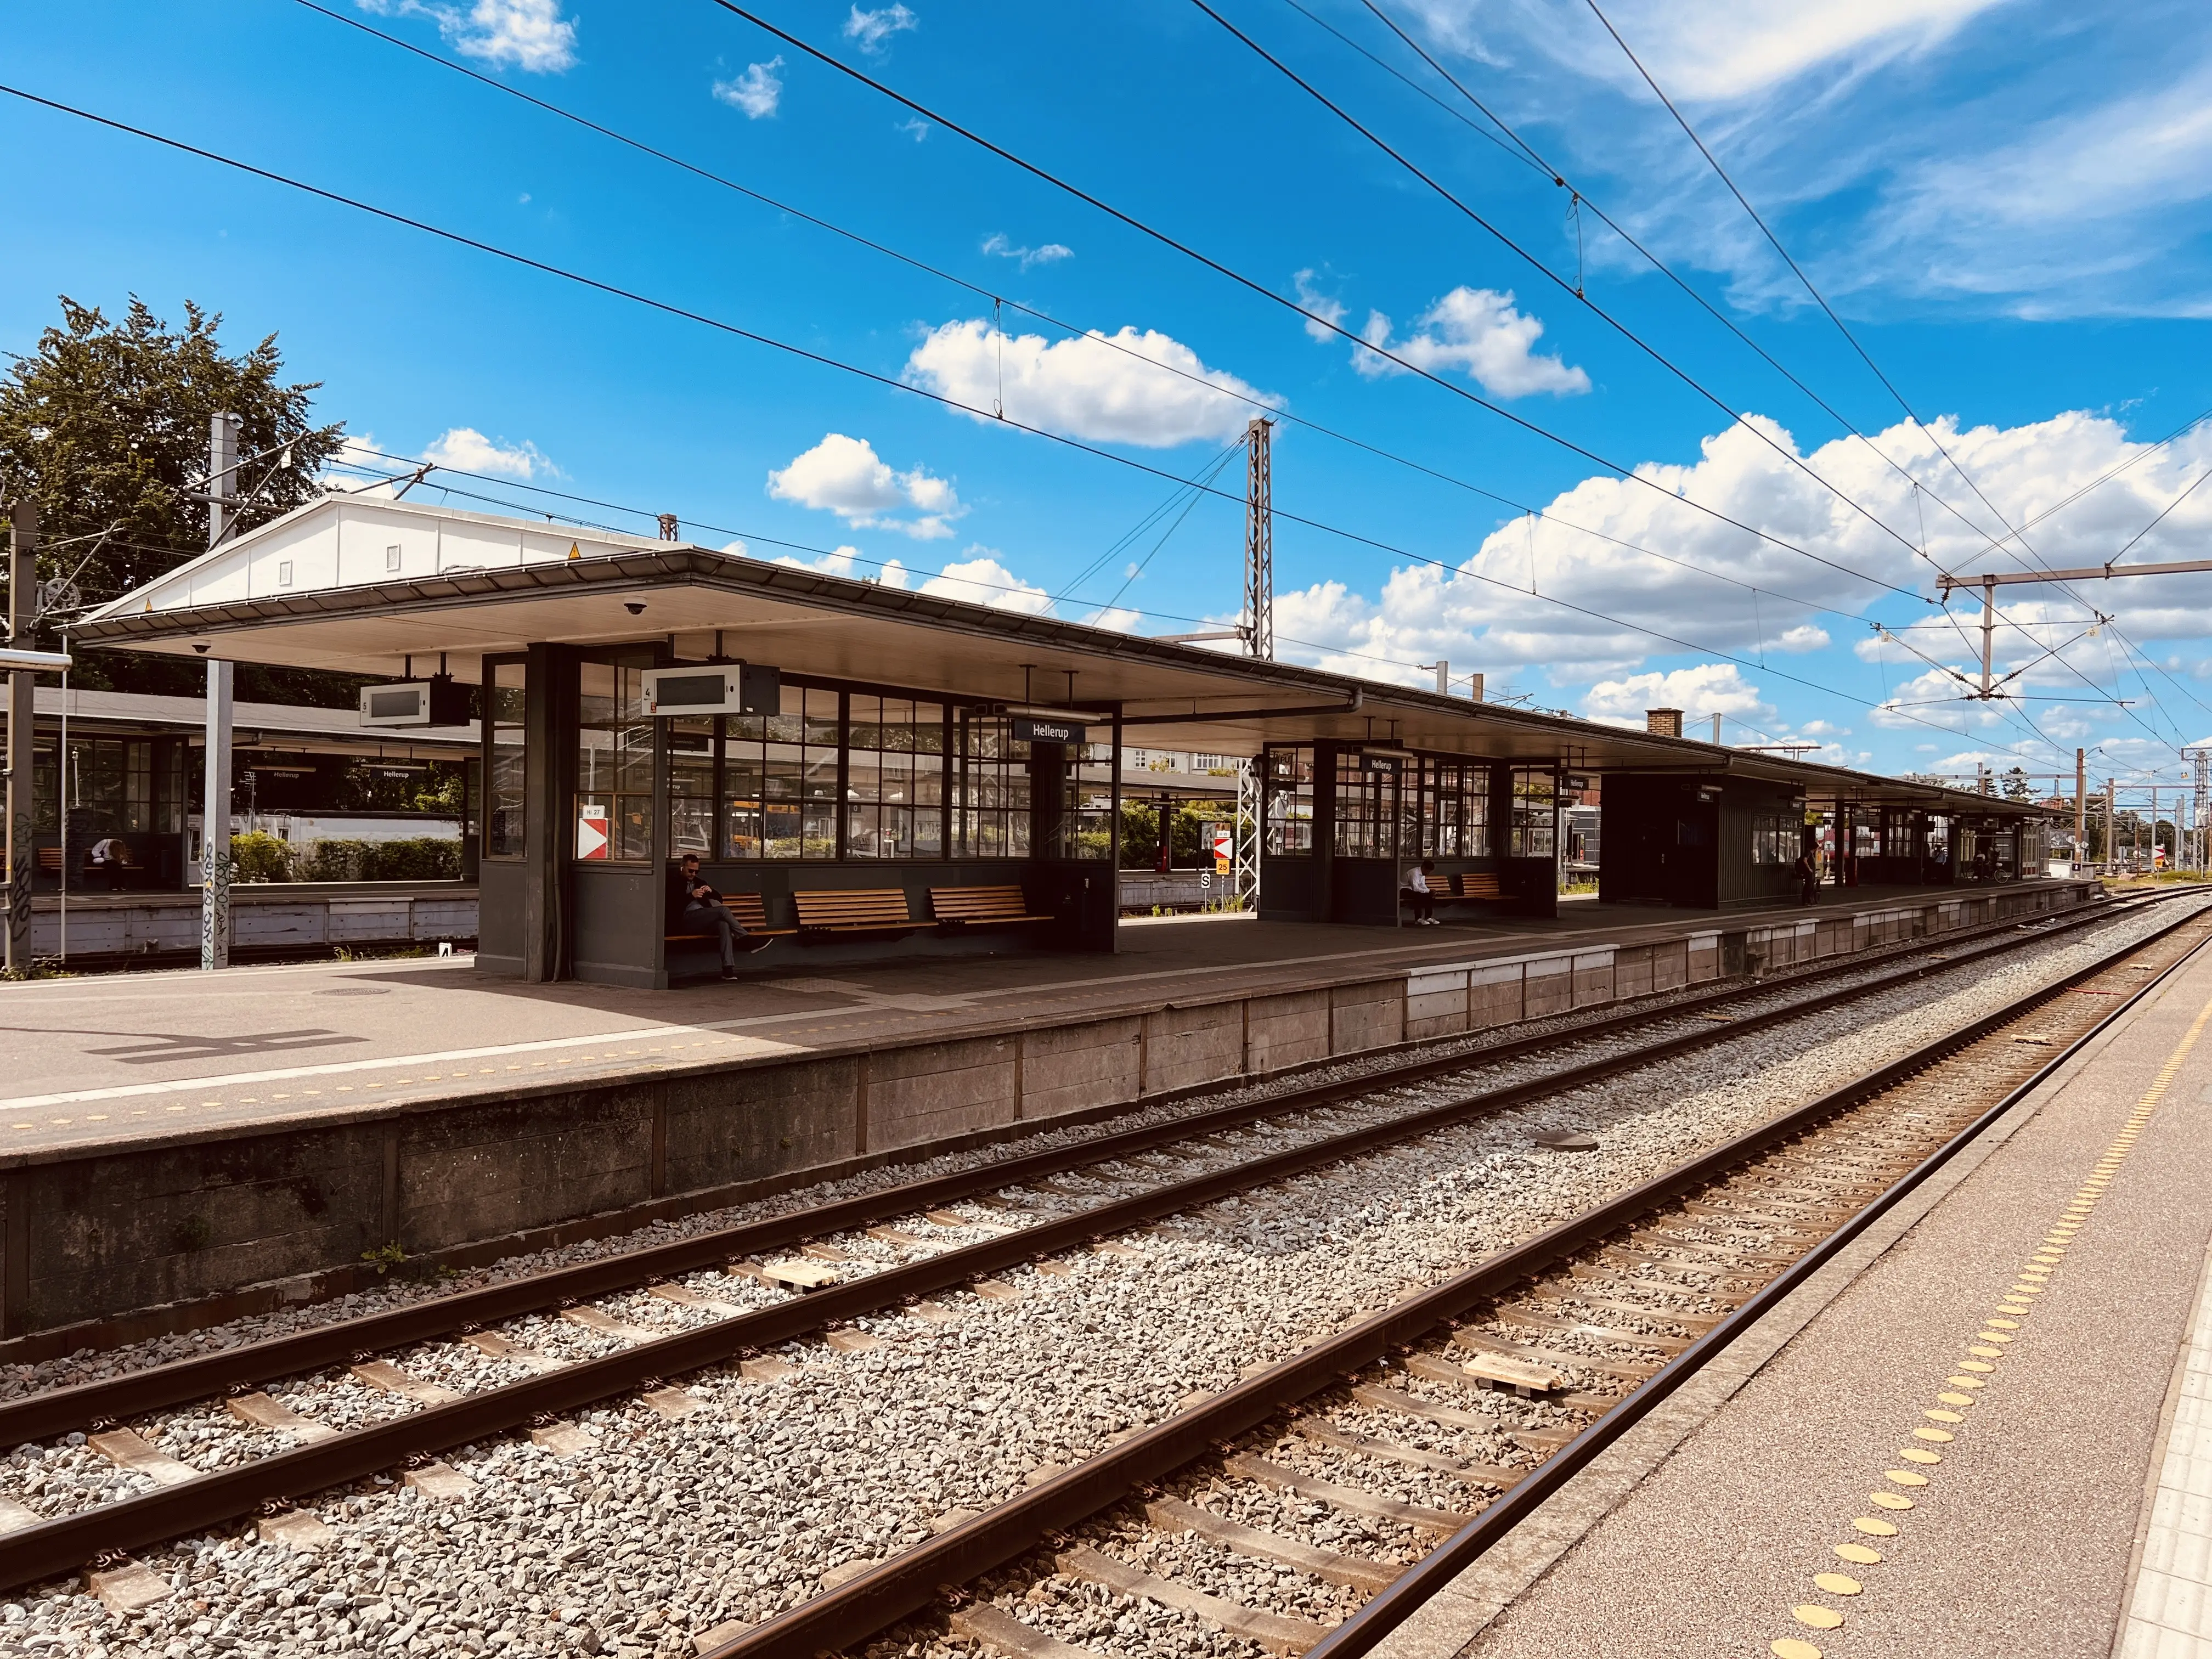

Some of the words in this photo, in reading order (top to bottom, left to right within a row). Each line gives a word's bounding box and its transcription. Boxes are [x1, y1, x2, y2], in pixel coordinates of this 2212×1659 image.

[645, 688, 650, 697] 4
[1033, 724, 1069, 741] Hellerup
[1372, 759, 1392, 772] Hellerup
[383, 770, 409, 779] Hellerup
[1201, 876, 1210, 887] S
